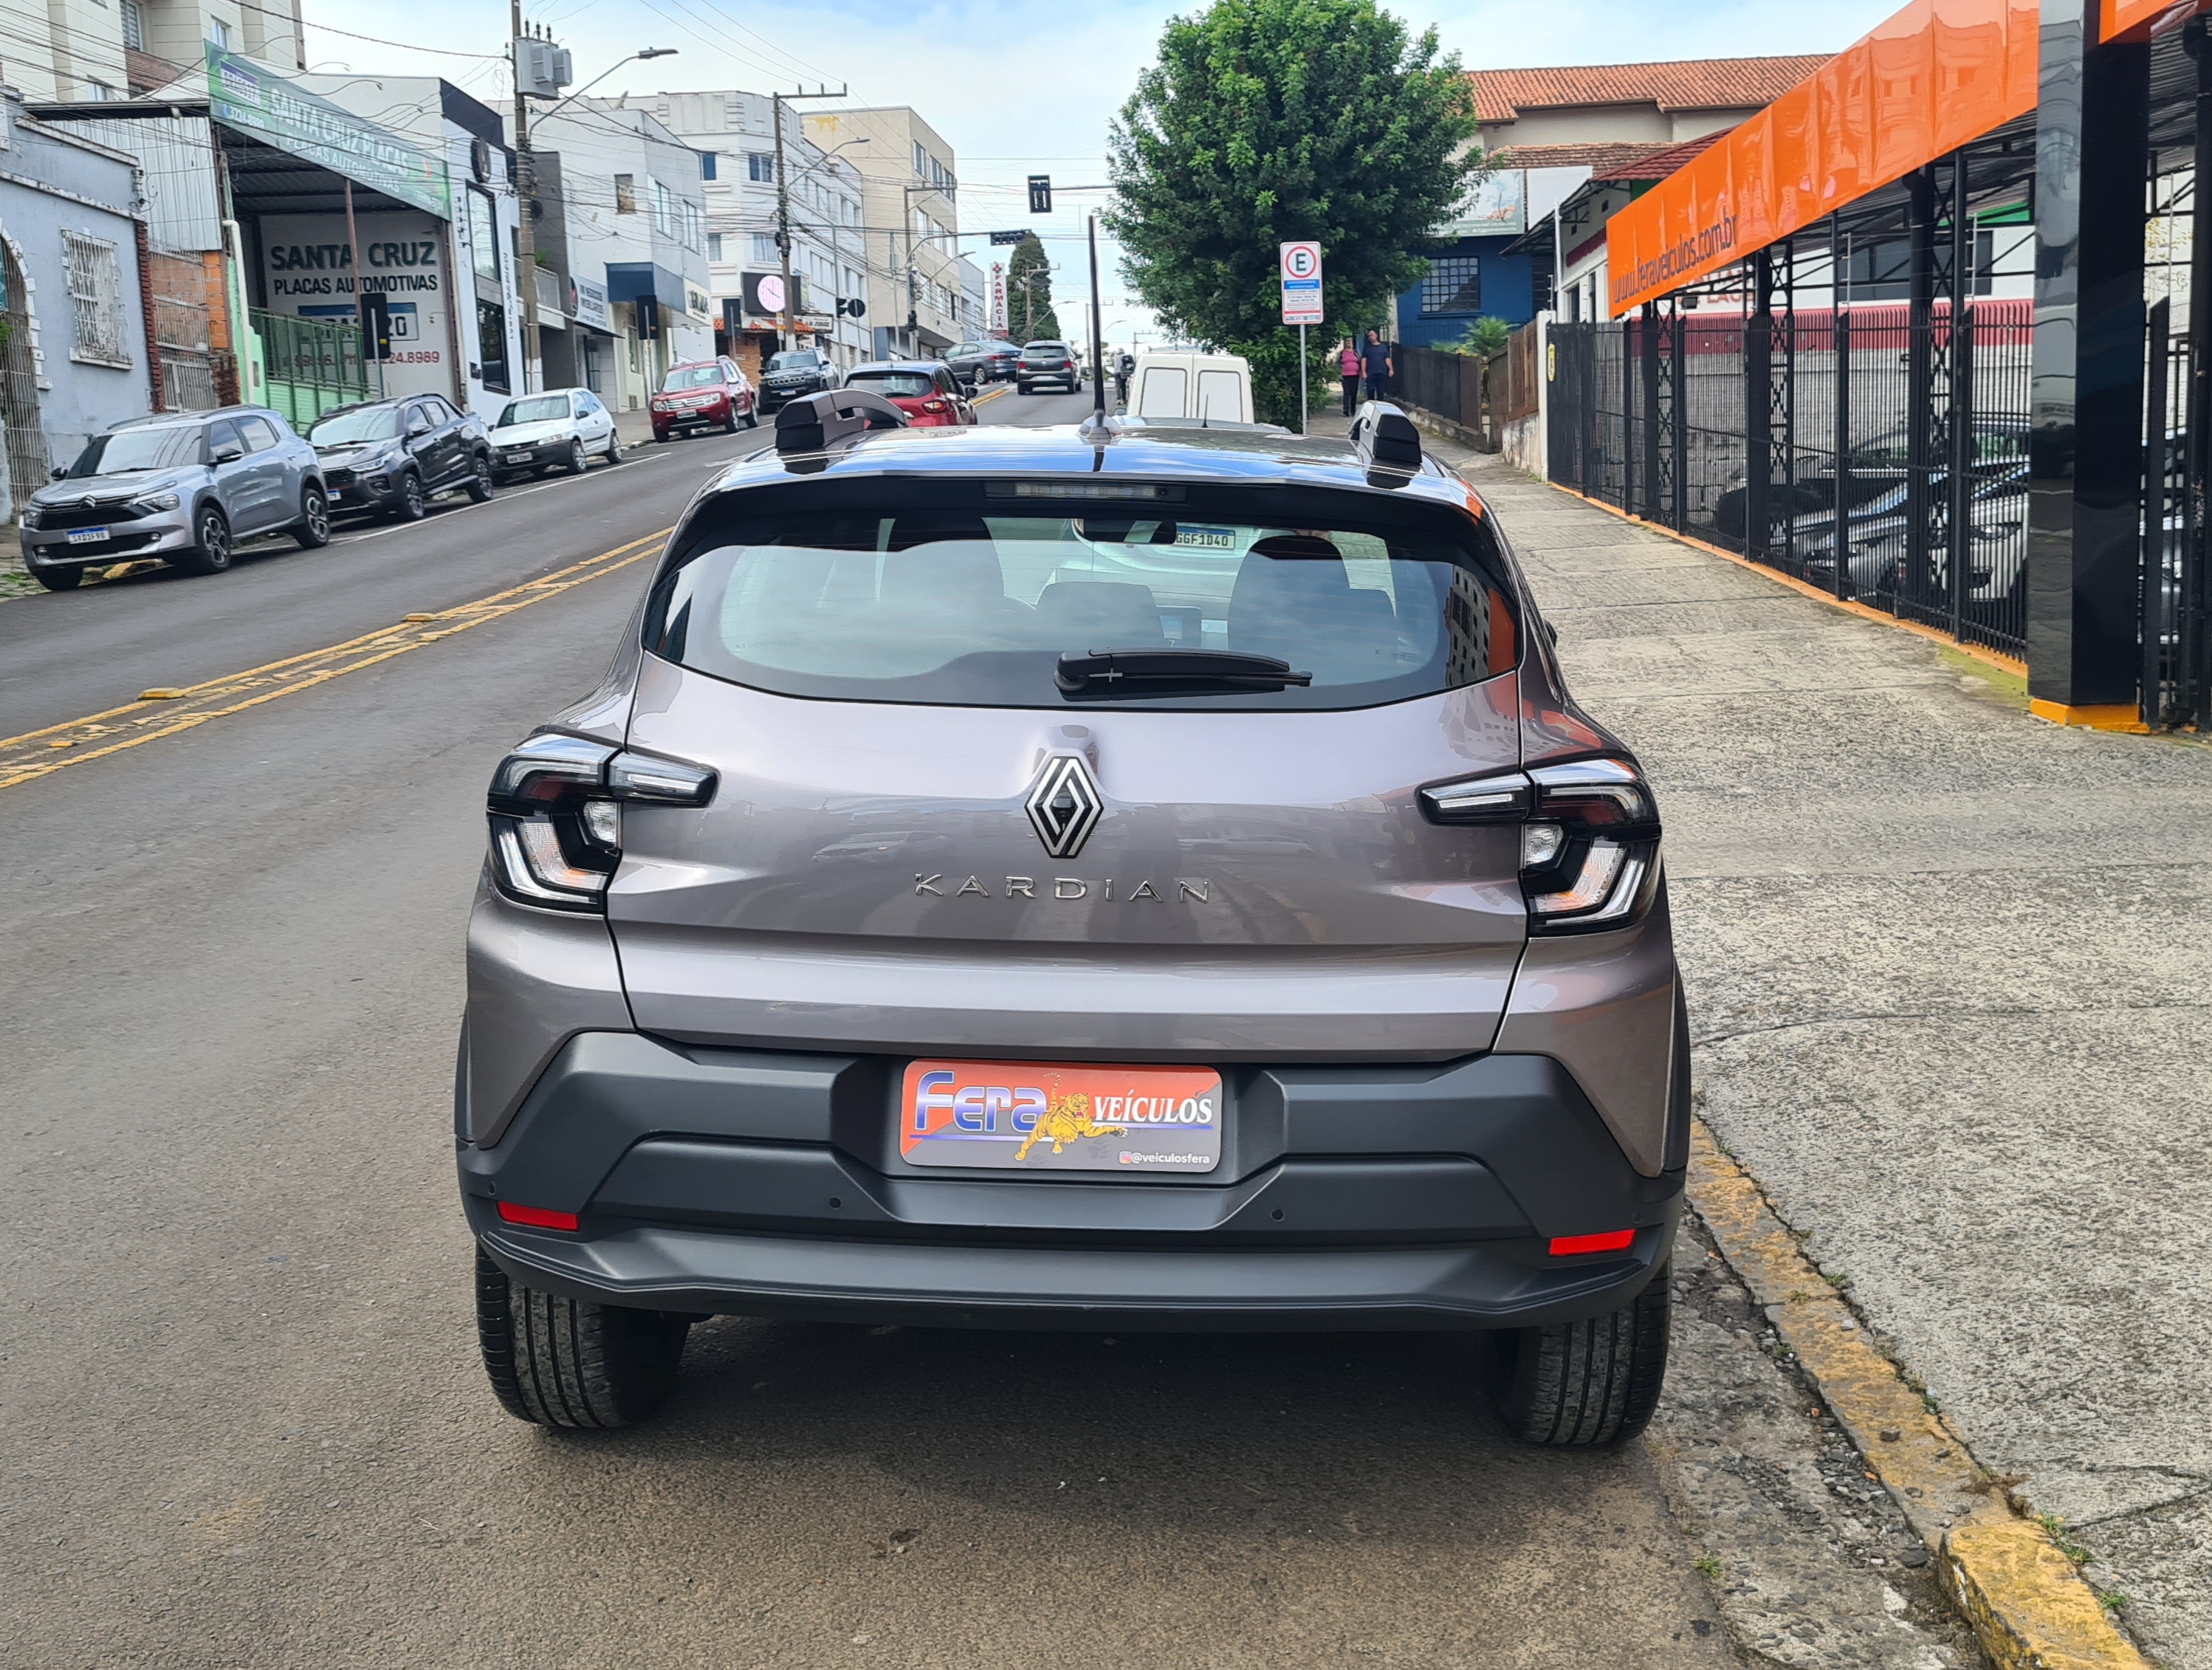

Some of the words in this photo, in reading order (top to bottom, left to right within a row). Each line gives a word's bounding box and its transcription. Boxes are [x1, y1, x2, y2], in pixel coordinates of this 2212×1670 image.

[270, 88, 322, 139] SANTA
[322, 114, 360, 157] CRUZ
[286, 131, 330, 162] PLACAS
[332, 151, 400, 193] AUTOMOTIVAS
[271, 244, 352, 270] SANTA
[368, 241, 437, 267] CRUZ
[1296, 253, 1306, 271] E
[1613, 206, 1737, 304] www.feraveiculos.com.br
[274, 277, 332, 295] PLACAS
[336, 275, 438, 294] AUTOMOTIVAS
[1175, 532, 1229, 547] GGF1D40
[914, 873, 1209, 904] KARDIAN
[914, 1070, 1048, 1133] Fera
[1093, 1088, 1213, 1124] VEÍCULOS
[1131, 1152, 1210, 1164] @veiculosfera
